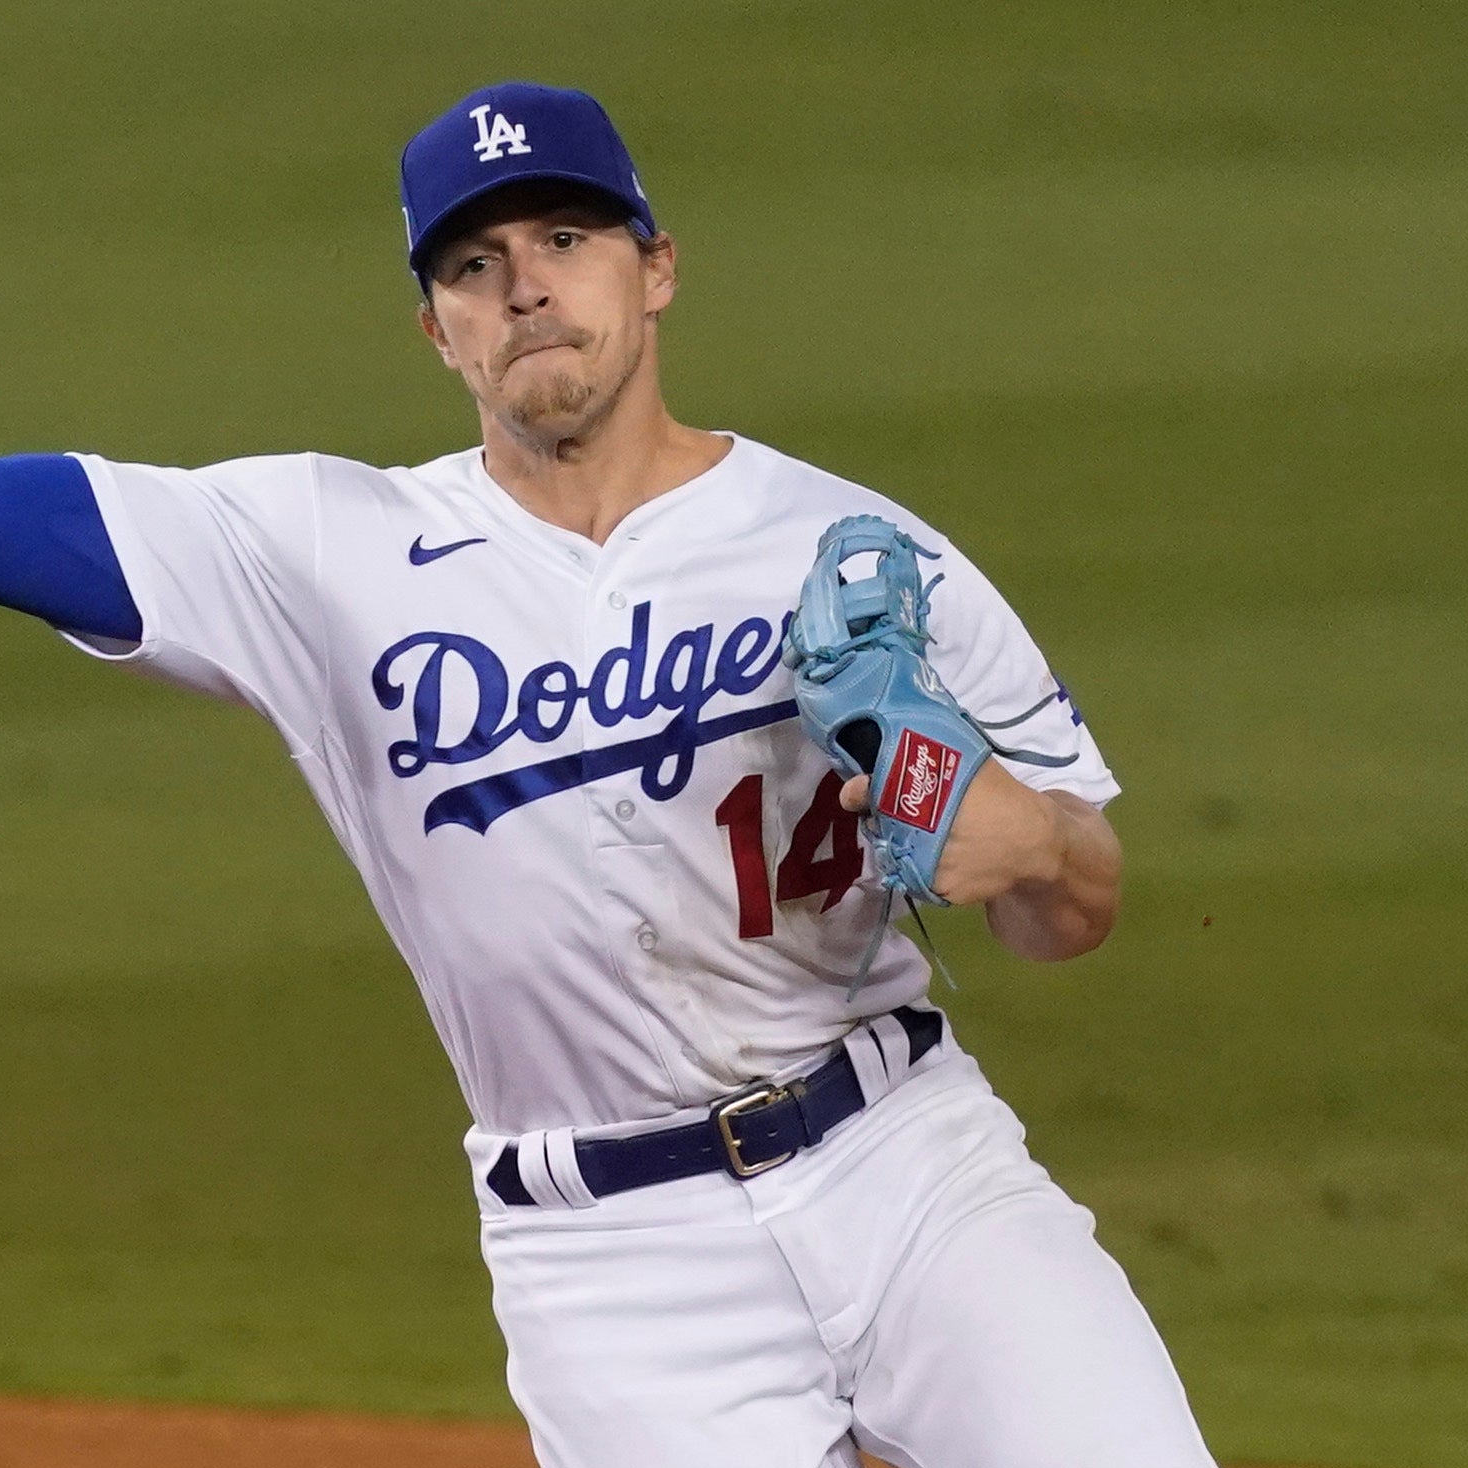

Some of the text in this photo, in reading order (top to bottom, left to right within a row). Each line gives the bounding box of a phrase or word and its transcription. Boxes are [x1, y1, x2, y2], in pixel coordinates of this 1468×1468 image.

[469, 104, 532, 162] LA
[372, 601, 795, 801] Dodge
[899, 743, 937, 817] Rawlings
[715, 768, 864, 939] 14
